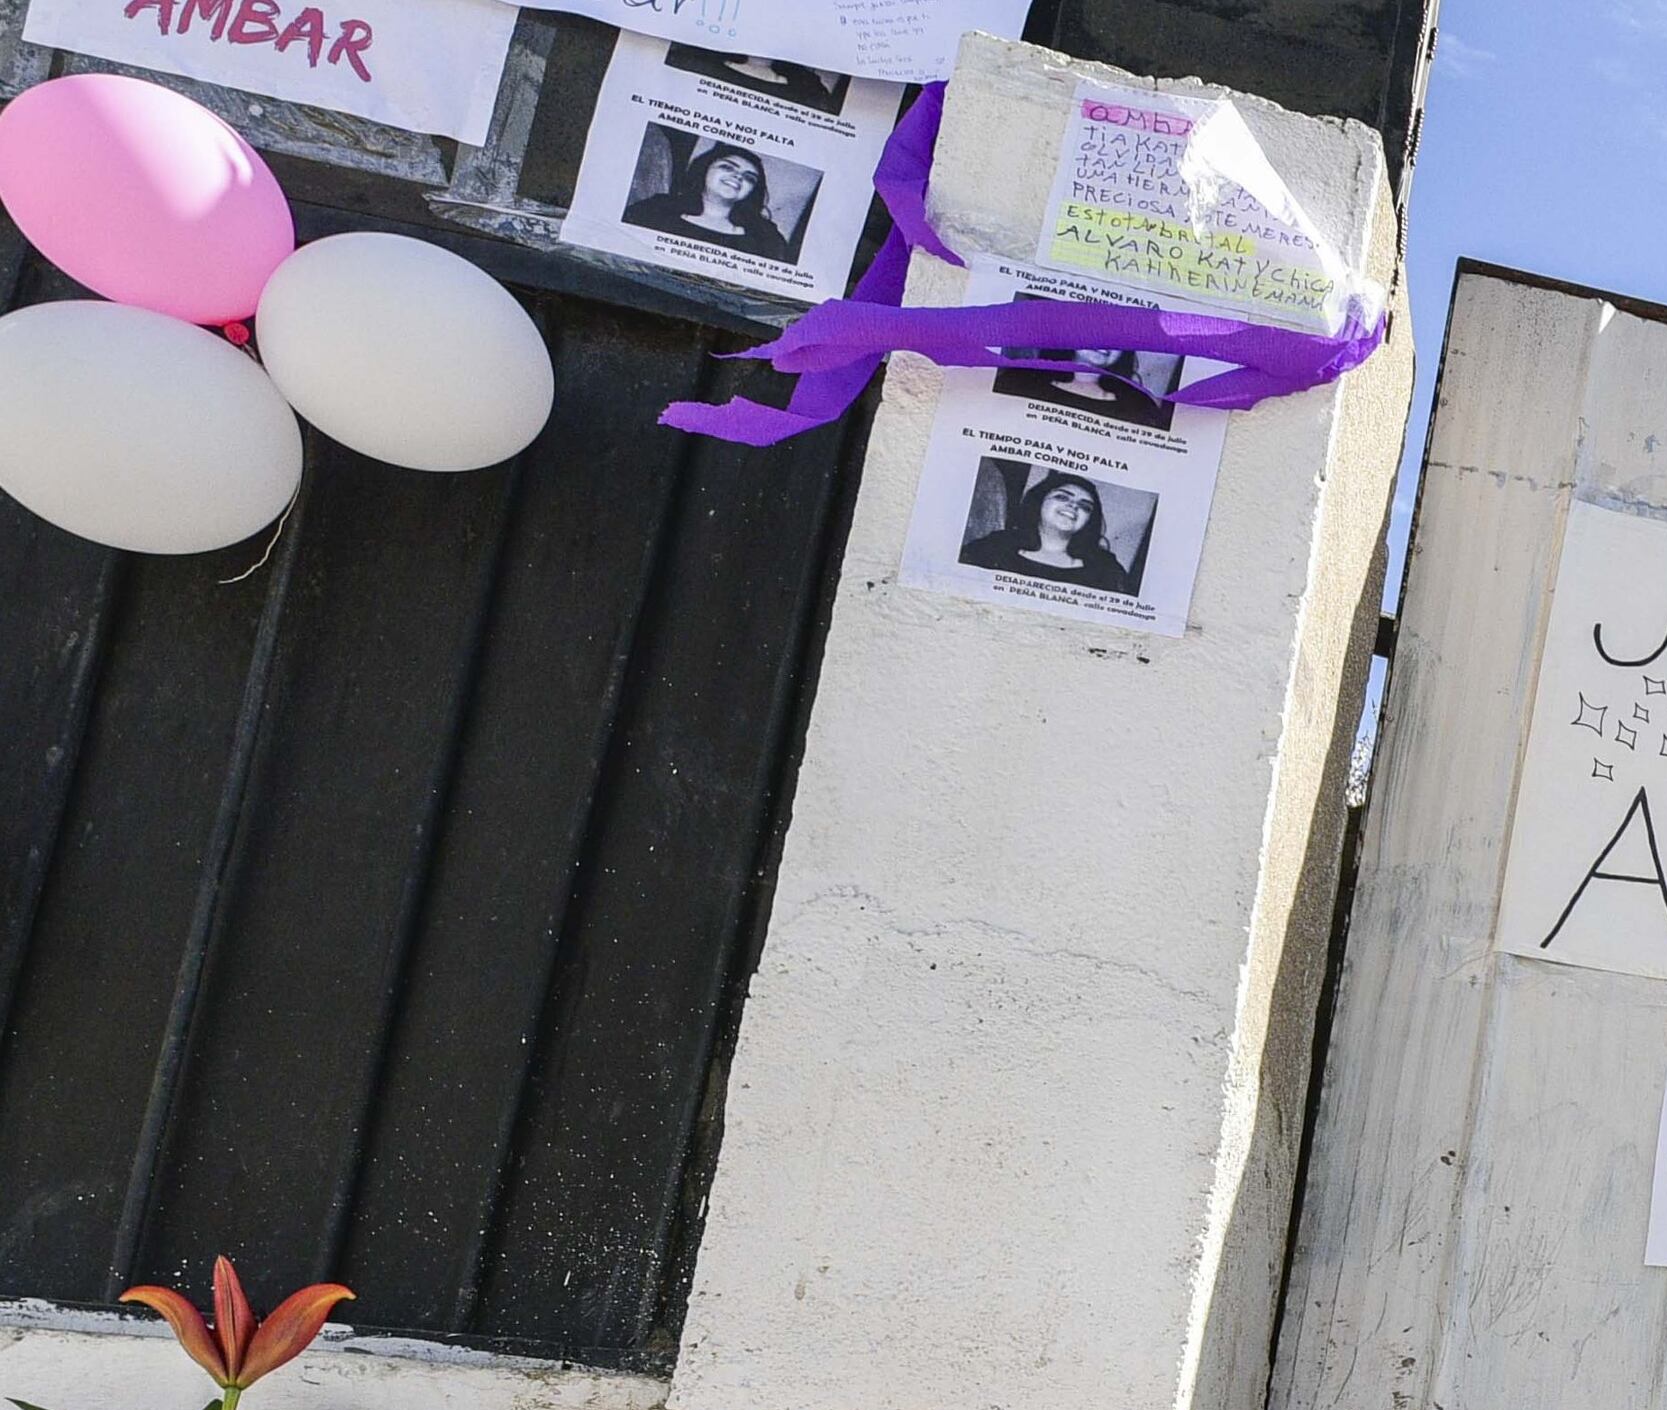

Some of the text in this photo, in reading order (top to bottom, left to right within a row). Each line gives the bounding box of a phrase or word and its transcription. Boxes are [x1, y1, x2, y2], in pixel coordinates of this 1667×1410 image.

[700, 78, 770, 105] DESAPARECIDA
[742, 100, 780, 117] BLANCA
[632, 95, 644, 103] EL
[649, 98, 691, 116] TIEMPO
[694, 111, 721, 125] PASA
[736, 124, 758, 136] NOS
[760, 131, 795, 147] FALTA
[658, 112, 755, 145] AMBAR CORNEJO
[657, 235, 728, 259] DESAPARECIDA
[1057, 226, 1182, 259] ALVARO
[699, 255, 738, 270] BLANCA
[1000, 266, 1012, 275] EL
[1016, 270, 1057, 284] TIEMPO
[1060, 280, 1087, 291] PASA
[1101, 289, 1123, 301] NOS
[1126, 297, 1160, 310] FALTA
[1026, 283, 1066, 296] AMBAR
[1028, 402, 1100, 426] DESAPARECIDA
[1071, 422, 1111, 438] BLANCA
[962, 428, 975, 437] EL
[979, 431, 1021, 445] TIEMPO
[1025, 439, 1053, 452] PASA
[1067, 449, 1090, 461] NOS
[1093, 456, 1129, 471] FALTA
[990, 444, 1088, 472] AMBAR CORNEJO
[995, 574, 1067, 594] DESAPARECIDA
[1039, 592, 1078, 606] BLANCA
